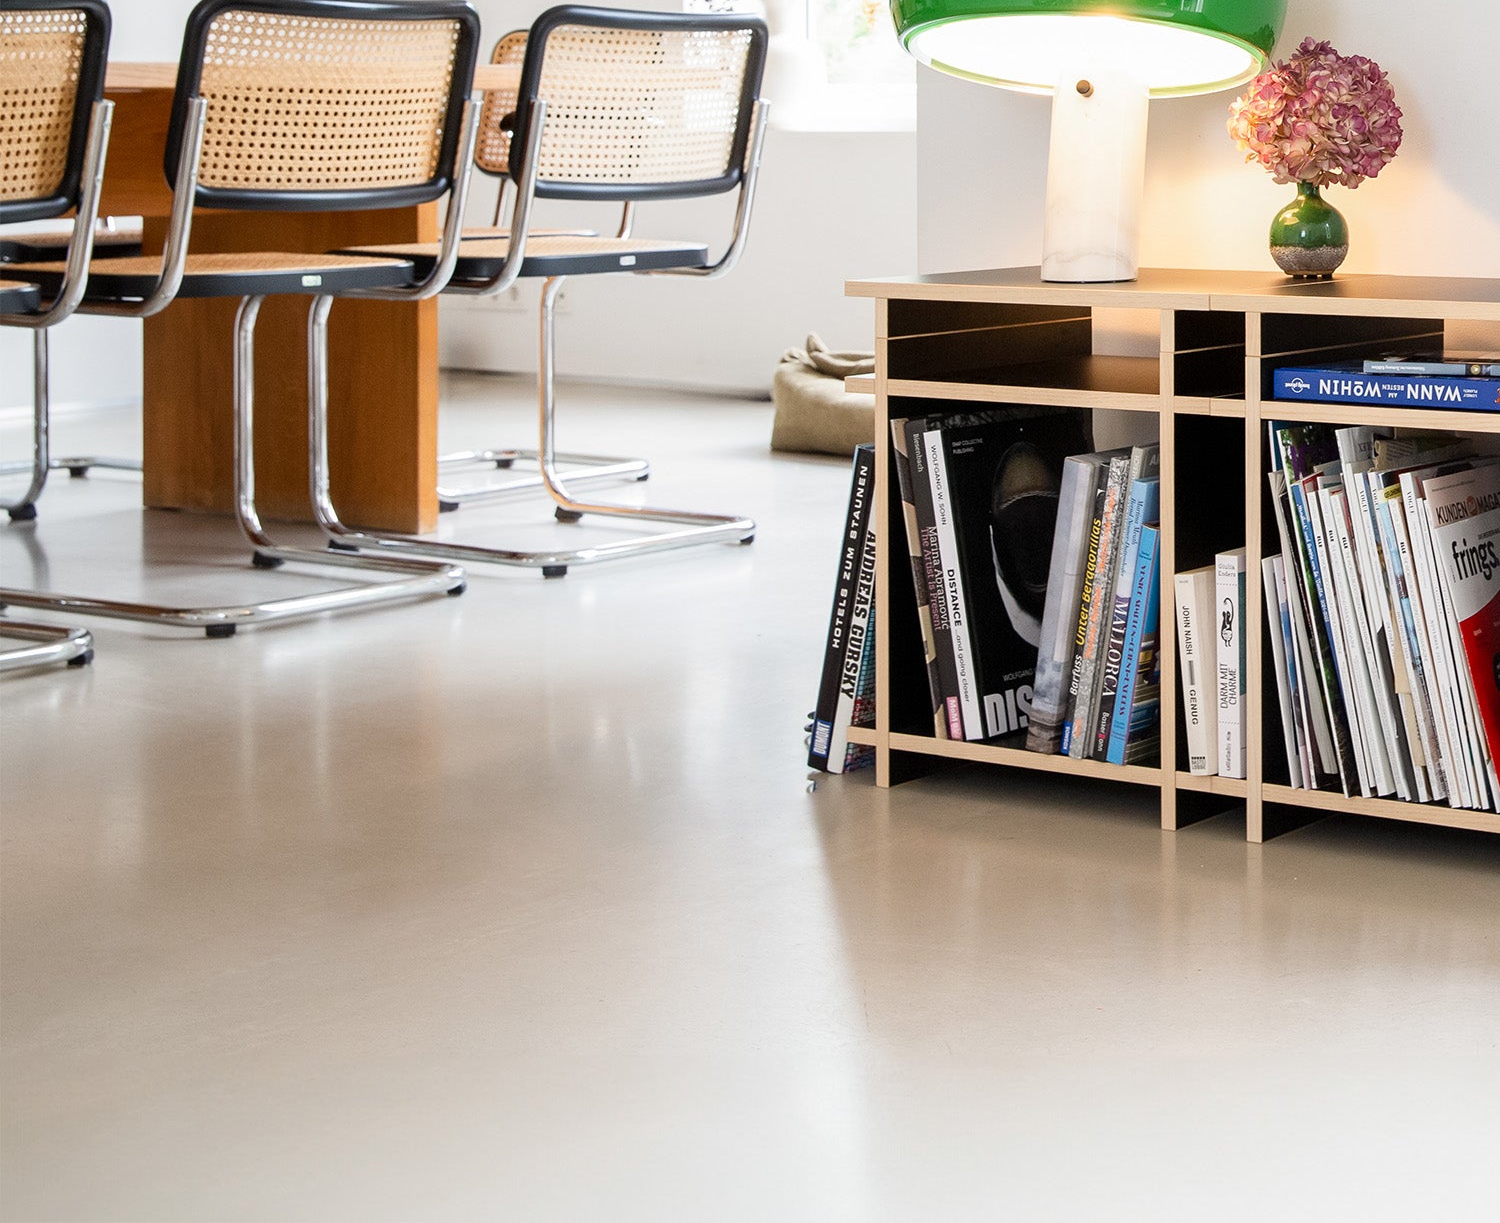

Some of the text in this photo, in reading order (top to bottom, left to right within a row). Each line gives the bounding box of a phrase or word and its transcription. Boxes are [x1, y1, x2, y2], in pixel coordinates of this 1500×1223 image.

[1406, 384, 1462, 402] WANN
[913, 433, 925, 472] Biesenbach
[930, 445, 944, 490] WOLFGANG
[939, 502, 948, 526] SOHN
[1406, 492, 1414, 514] VOGUE
[1436, 500, 1468, 524] KUNDEN
[832, 465, 868, 649] HOTELS ZUM STAUNEN
[921, 528, 930, 547] The
[924, 549, 934, 578] Artist
[928, 526, 951, 630] Marina Abramović
[1082, 518, 1102, 604] Berggorillas
[1218, 563, 1236, 571] Giulia
[1218, 570, 1236, 578] Enders
[841, 529, 876, 700] ANDREAS GURSKY
[930, 592, 942, 631] Present
[1076, 604, 1090, 646] Unter
[948, 569, 962, 626] DISTANCE
[956, 653, 966, 677] going
[962, 678, 970, 703] closer
[1102, 600, 1130, 696] MALLORCA
[1002, 668, 1034, 682] WOLFGANG
[1070, 654, 1084, 696] Barfuss
[1182, 605, 1199, 726] JOHN NAISH GENUG
[1220, 663, 1228, 709] DARM MIT
[1228, 668, 1237, 706] CHARME
[1063, 726, 1071, 750] KOSMOS
